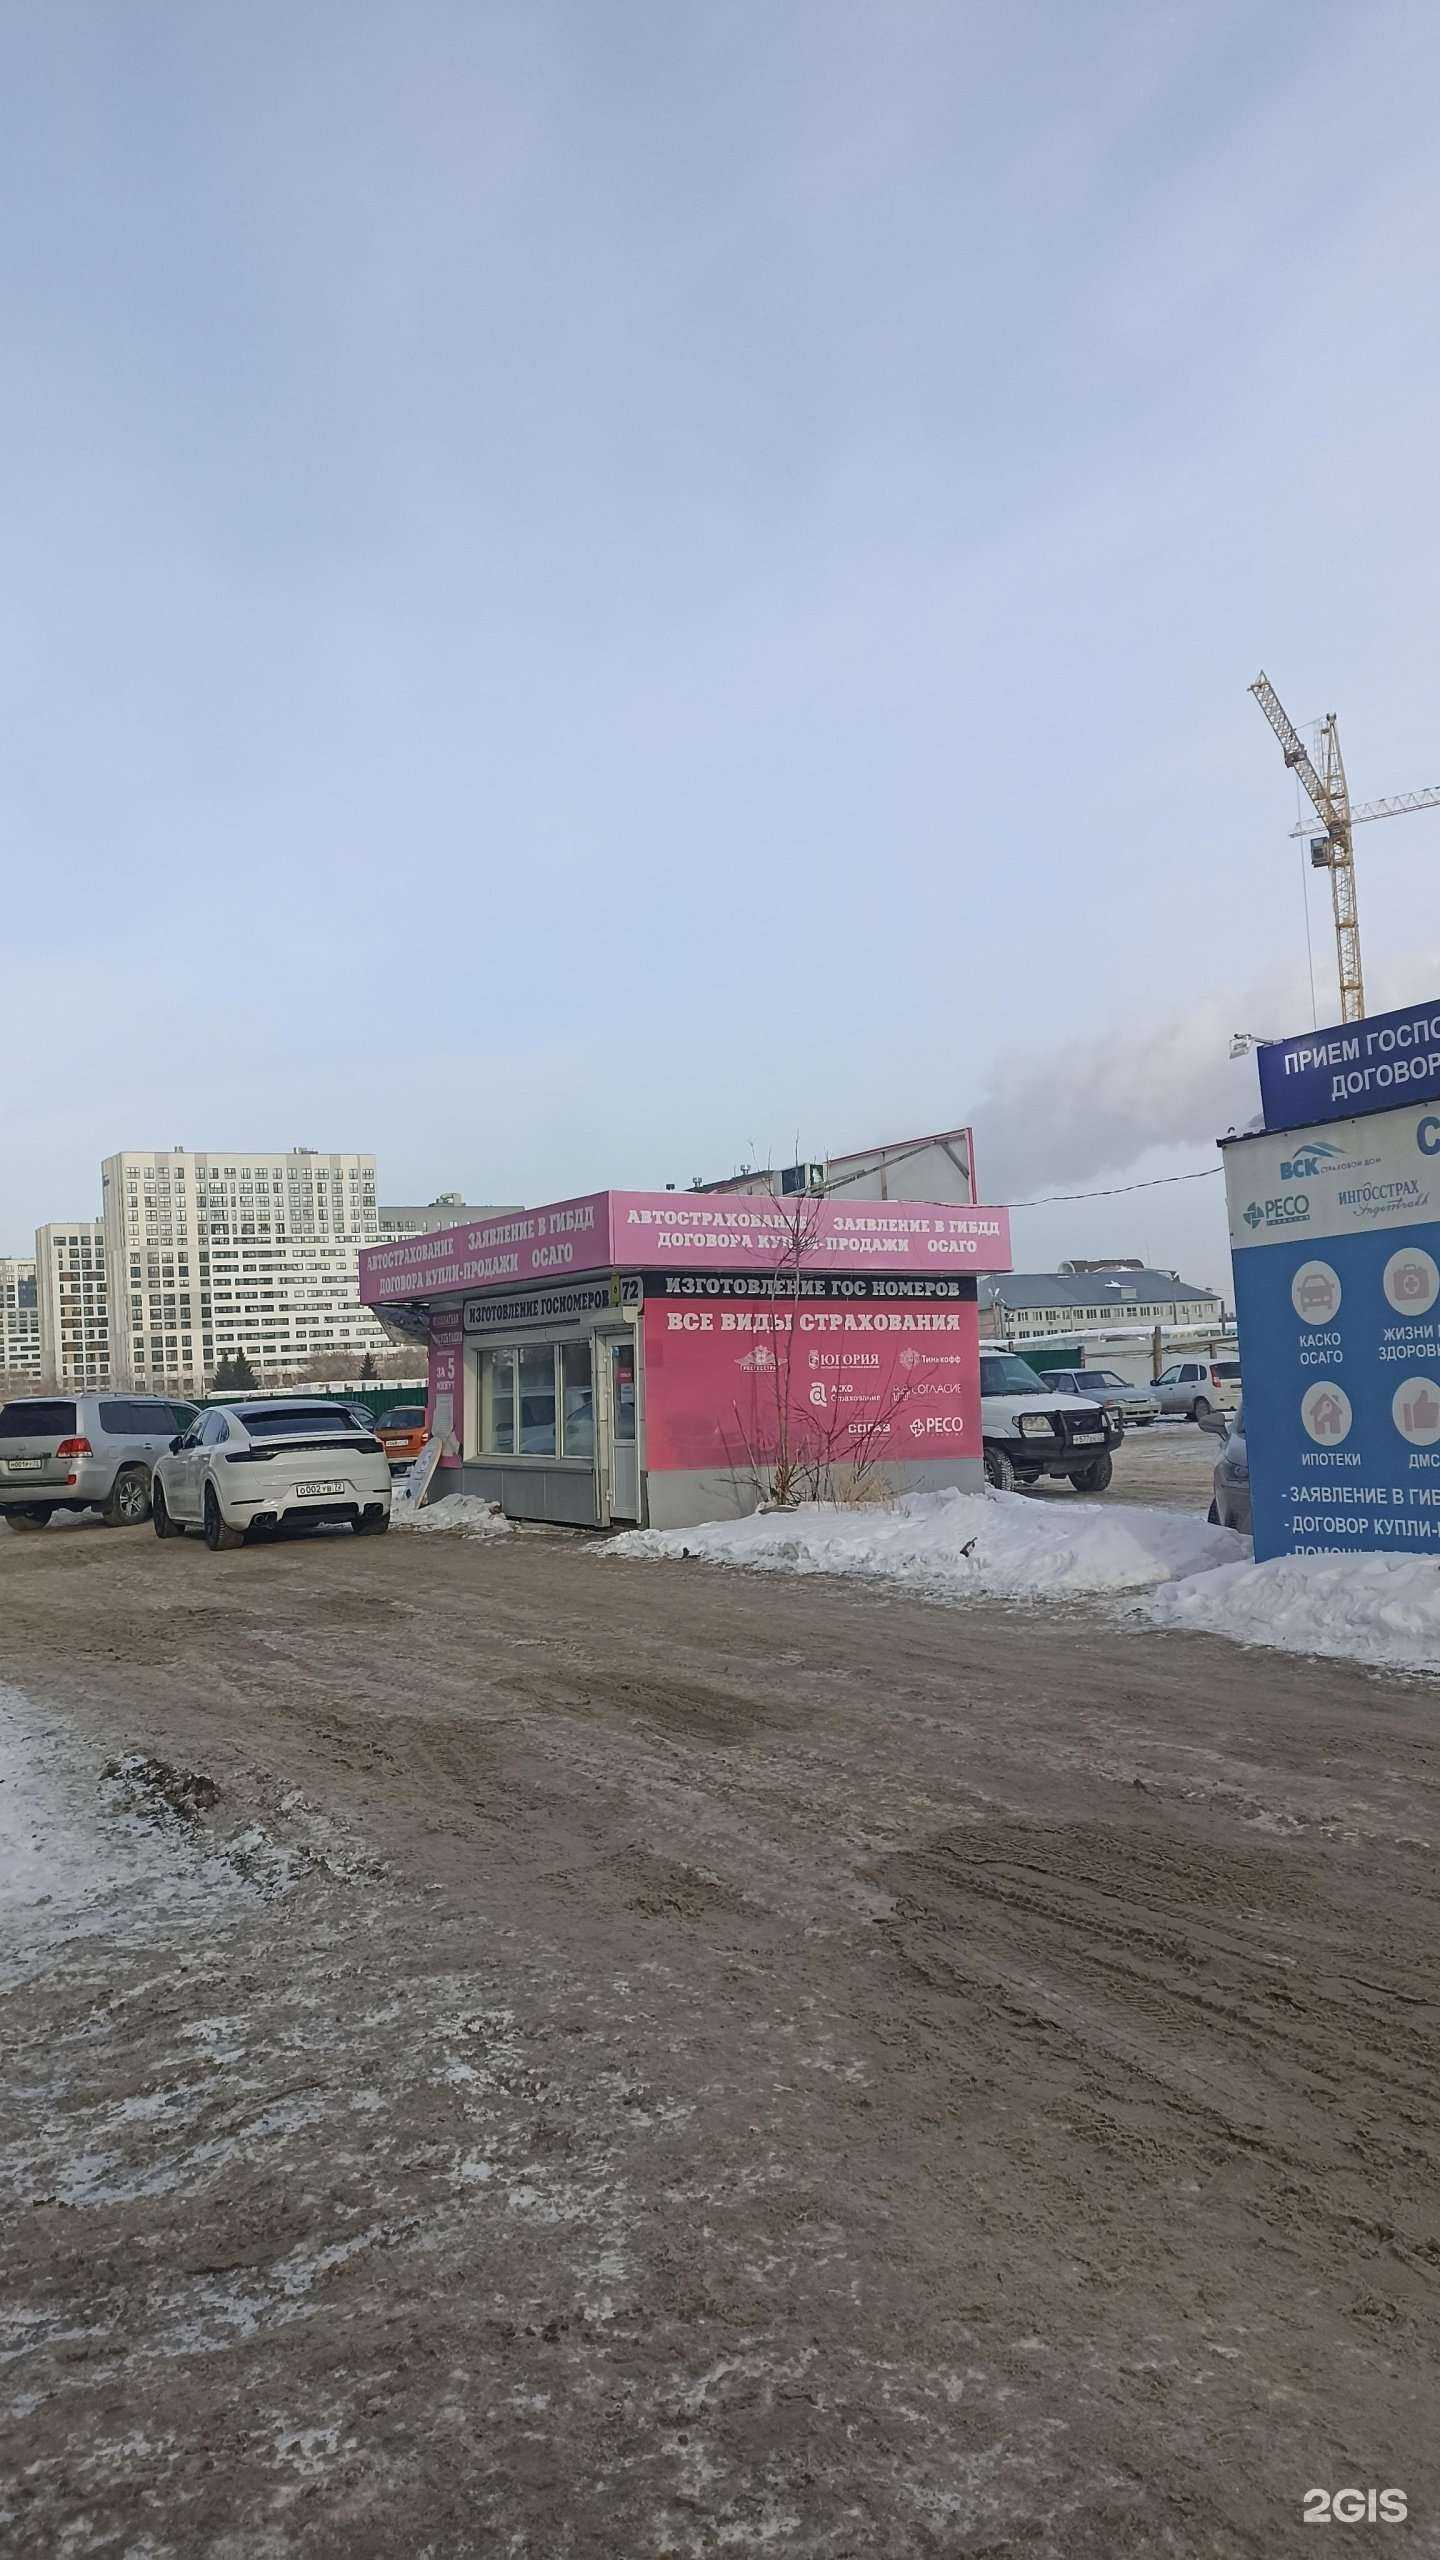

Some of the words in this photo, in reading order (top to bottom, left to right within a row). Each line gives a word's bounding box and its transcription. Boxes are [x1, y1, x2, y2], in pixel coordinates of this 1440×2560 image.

[1284, 1038, 1360, 1075] ПРИЕМ
[1331, 1052, 1440, 1101] ДОГОВОР
[1280, 1157, 1319, 1180] ВСК
[1338, 1180, 1419, 1205] ИНГОССТРАХ
[1265, 1195, 1309, 1219] РЕСО
[627, 1210, 807, 1229] АВТОСТРАХОВАНИЕ
[833, 1217, 930, 1233] ЗАЯВЛЕНИЕ
[935, 1219, 944, 1233] В
[949, 1220, 999, 1236] ГИБДД
[367, 1238, 454, 1272] АВТОСТРАХОВАНИЕ
[468, 1220, 534, 1250] ЗАЯВЛЕНИЕ
[538, 1217, 546, 1237] В
[549, 1206, 594, 1233] ГИБДД
[658, 1232, 753, 1249] ДОГОВОРА
[927, 1239, 977, 1253] ОСАГО
[379, 1272, 424, 1296] ДОГОВОРА
[426, 1253, 518, 1286] КУПЛИ-ПРОДАЖИ
[532, 1243, 573, 1268] ОСАГО
[665, 1277, 825, 1295] ИЗГОТОВЛЕНИЕ
[831, 1280, 867, 1296] ГОС
[872, 1281, 960, 1297] НОМЕРОВ
[469, 1300, 539, 1323] ИЗГОТОВЛЕНИЕ
[541, 1290, 609, 1316] ГОСНОМЕРОВ
[622, 1280, 639, 1300] 72
[667, 1312, 714, 1331] ВСЕ
[720, 1313, 793, 1333] ВИДЫ
[800, 1313, 960, 1331] СТРАХОВАНИЯ
[1300, 1332, 1341, 1347] КАСКО
[1384, 1325, 1433, 1341] ЖИЗНИ
[820, 1353, 880, 1366] ЮГОРИЯ
[1300, 1350, 1343, 1365] ОСАГО
[1379, 1344, 1440, 1361] ЗДОРОВ
[926, 1417, 963, 1432] РЕСО
[1302, 1454, 1361, 1466] ИПОТЕКИ
[1409, 1454, 1440, 1469] ДМС
[1290, 1486, 1388, 1505] ЗАЯВЛЕНИЕ
[1392, 1488, 1404, 1504] В
[1292, 1516, 1369, 1534] ДОГОВОР
